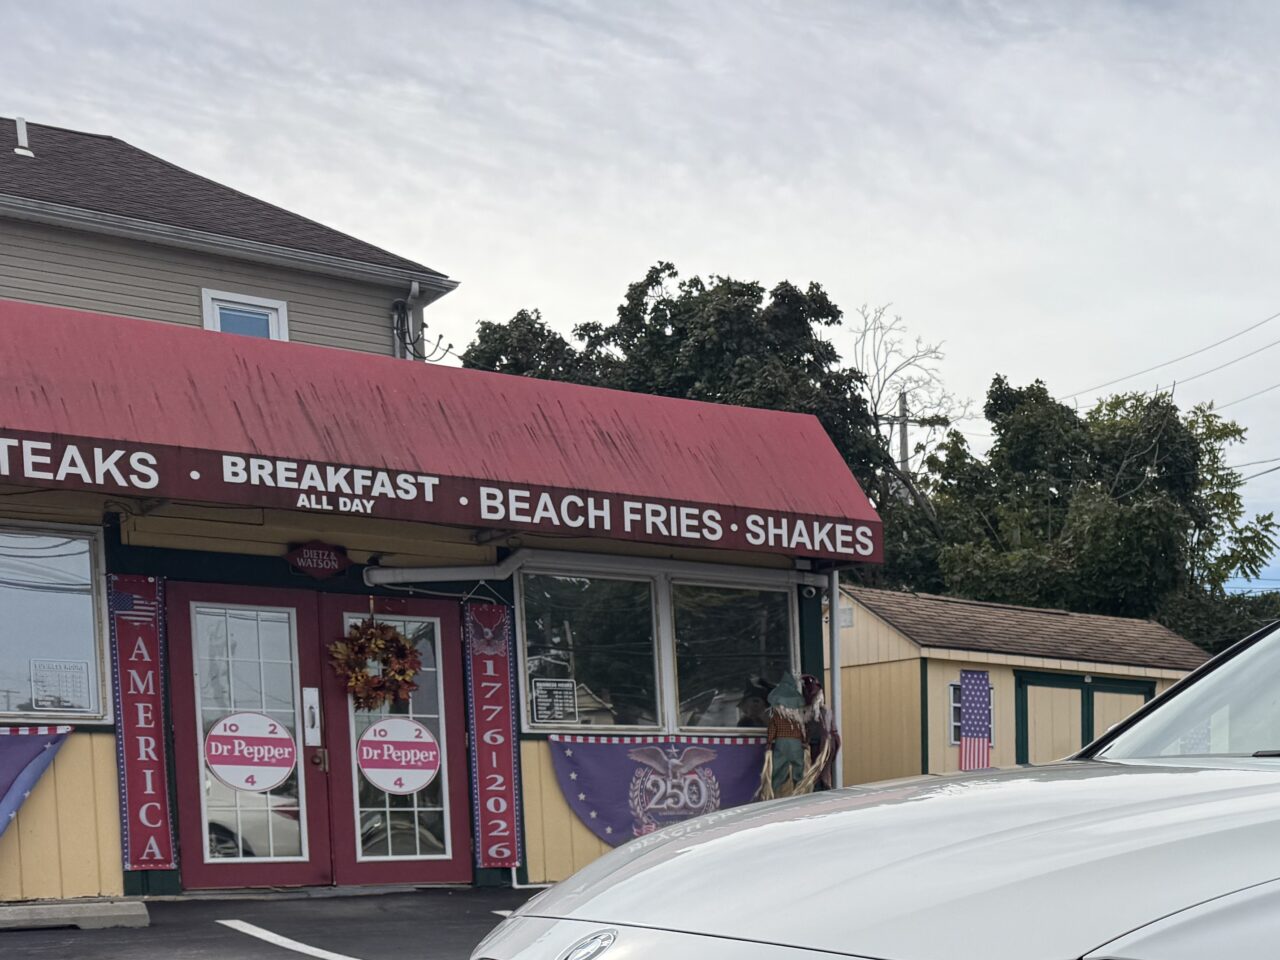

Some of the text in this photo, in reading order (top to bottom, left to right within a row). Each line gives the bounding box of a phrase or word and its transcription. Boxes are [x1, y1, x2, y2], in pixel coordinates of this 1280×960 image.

[0, 437, 160, 490] TEAKS
[222, 455, 439, 502] BREAKFAST
[296, 493, 376, 514] ALL DAY
[479, 486, 723, 541] BEACH FRIES
[745, 514, 874, 556] SHAKES
[296, 557, 339, 569] WATSON
[223, 723, 278, 735] 10 2
[373, 728, 423, 739] 10 2
[128, 636, 165, 860] AMERICA
[210, 739, 293, 762] Dr Pepper
[362, 744, 437, 766] Dr Pepper
[244, 774, 257, 786] 4
[393, 777, 405, 788] 4
[646, 774, 708, 809] 250
